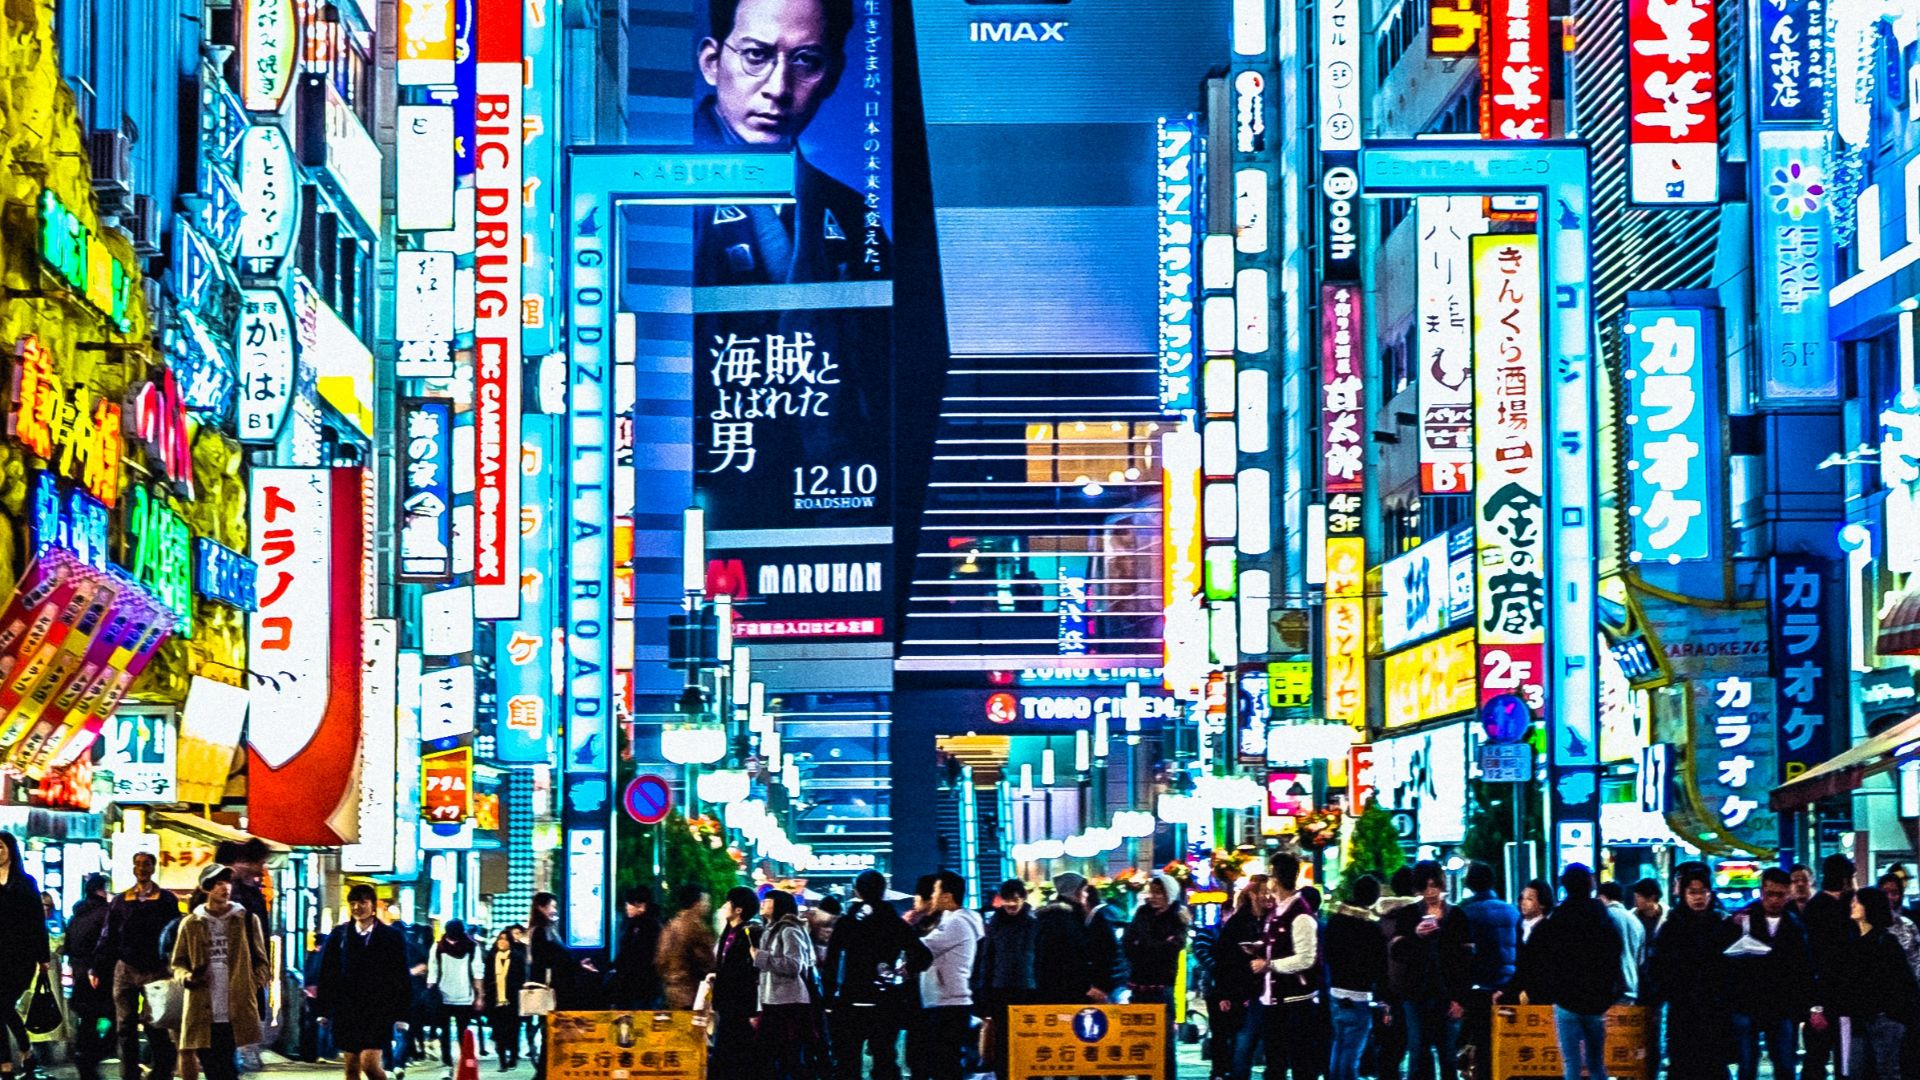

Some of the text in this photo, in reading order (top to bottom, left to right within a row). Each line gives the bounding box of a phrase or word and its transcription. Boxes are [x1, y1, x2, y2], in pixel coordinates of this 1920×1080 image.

[970, 22, 1066, 41] IMAX
[476, 94, 510, 319] BIC DRUG
[248, 258, 275, 273] 1F
[709, 331, 841, 387] 海賊と
[1497, 247, 1528, 431] きんくら酒場
[1780, 341, 1820, 368] 5F
[248, 413, 275, 430] B1
[710, 386, 830, 420] よばれた
[708, 422, 757, 473] 男
[1322, 374, 1364, 481] 甘太郎
[1639, 316, 1702, 550] カラオケ
[573, 248, 603, 717] GODZILLA ROAD
[793, 464, 878, 496] 12.10
[1431, 462, 1473, 492] B1
[794, 497, 876, 509] ROADSHOW
[1329, 494, 1362, 513] 4F
[1329, 514, 1362, 532] 3F
[259, 486, 296, 652] トラノコ
[758, 561, 882, 595] MARUHAN
[1483, 481, 1544, 635] 金の蔵
[1781, 566, 1825, 751] カラオケ
[1715, 676, 1759, 828] カラオケ
